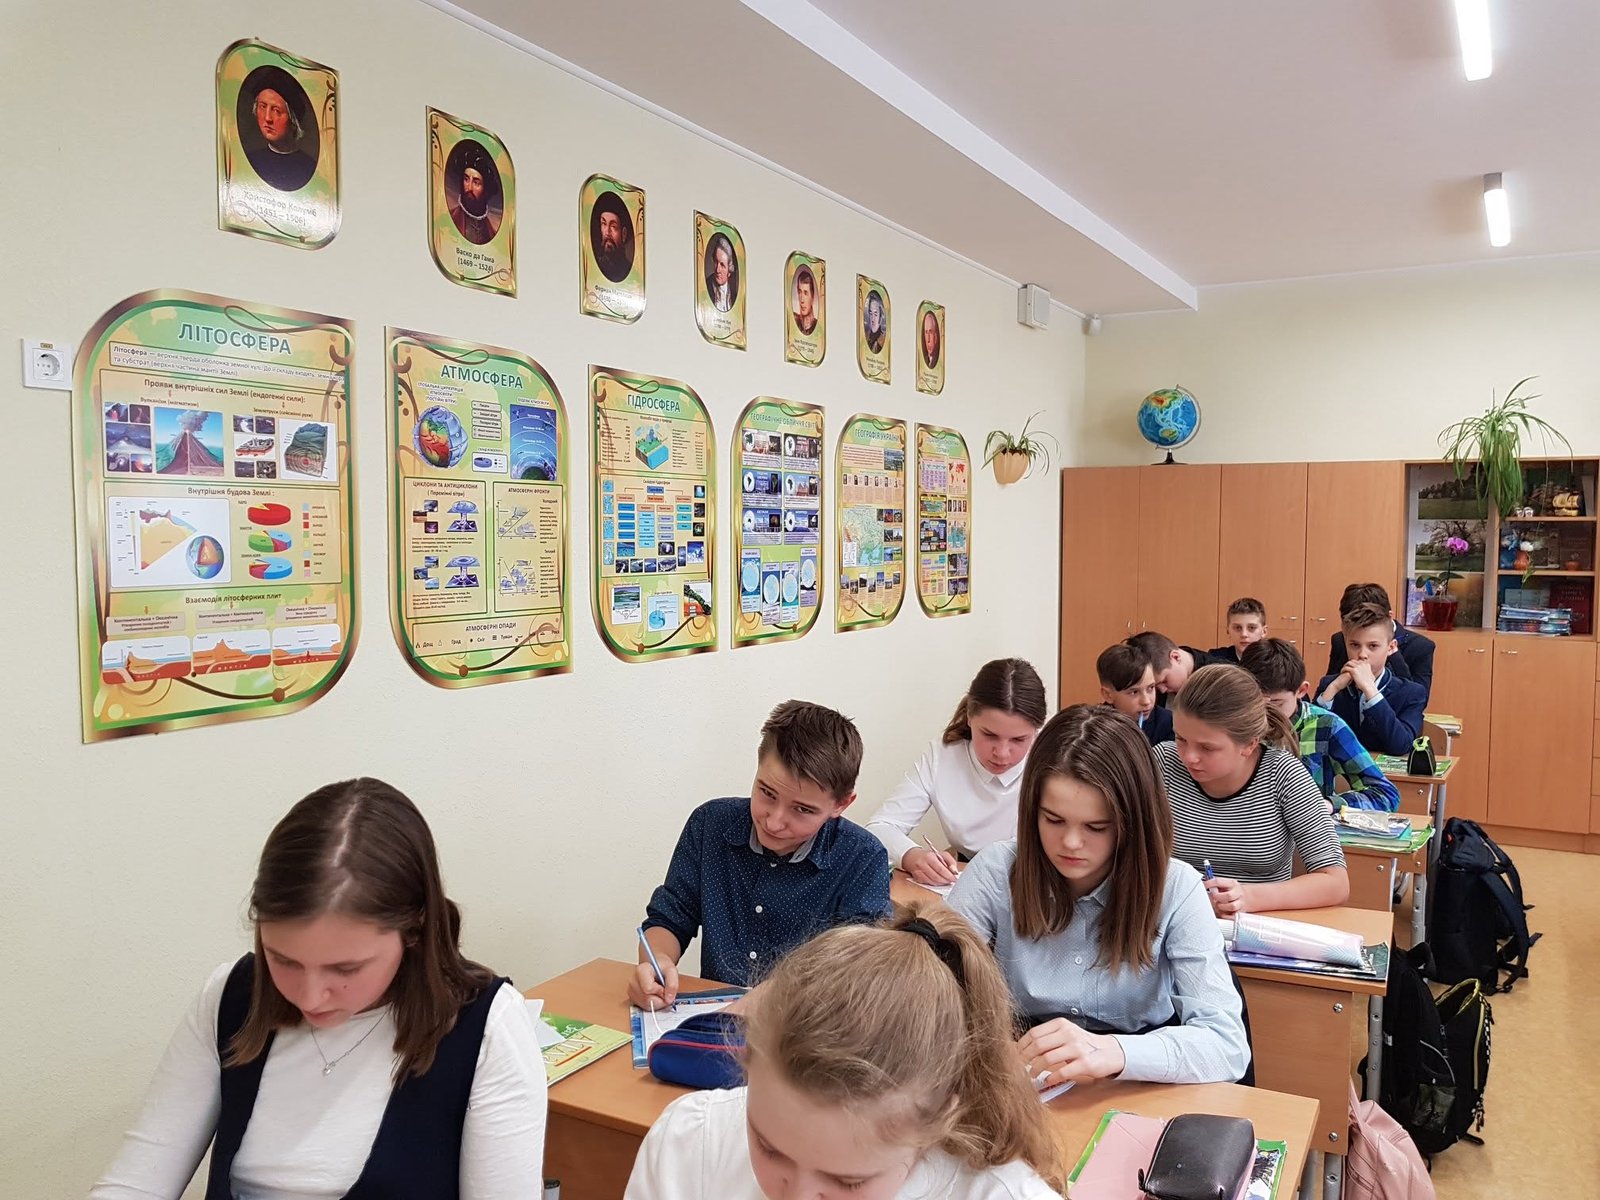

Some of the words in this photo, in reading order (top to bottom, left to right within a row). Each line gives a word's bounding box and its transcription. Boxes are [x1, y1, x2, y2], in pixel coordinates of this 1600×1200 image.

[456, 247, 472, 258] Васко
[481, 254, 494, 264] Гама
[458, 257, 473, 268] (1469
[178, 323, 292, 355] ЛІТОСФЕРА
[114, 346, 148, 356] Літосфера
[202, 357, 230, 366] оболонка
[122, 358, 150, 368] субстрат
[441, 364, 522, 389] АТМОСФЕРА
[144, 378, 173, 390] Прояви
[175, 384, 214, 394] внутрішніх
[230, 388, 249, 397] Землі
[628, 394, 680, 412] ГІДРОСФЕРА
[188, 486, 225, 496] Внутрішня
[226, 488, 251, 496] будова
[186, 596, 222, 604] Взаємодія
[223, 593, 265, 602] літосферних
[466, 624, 498, 632] АТМОСФЕРНІ
